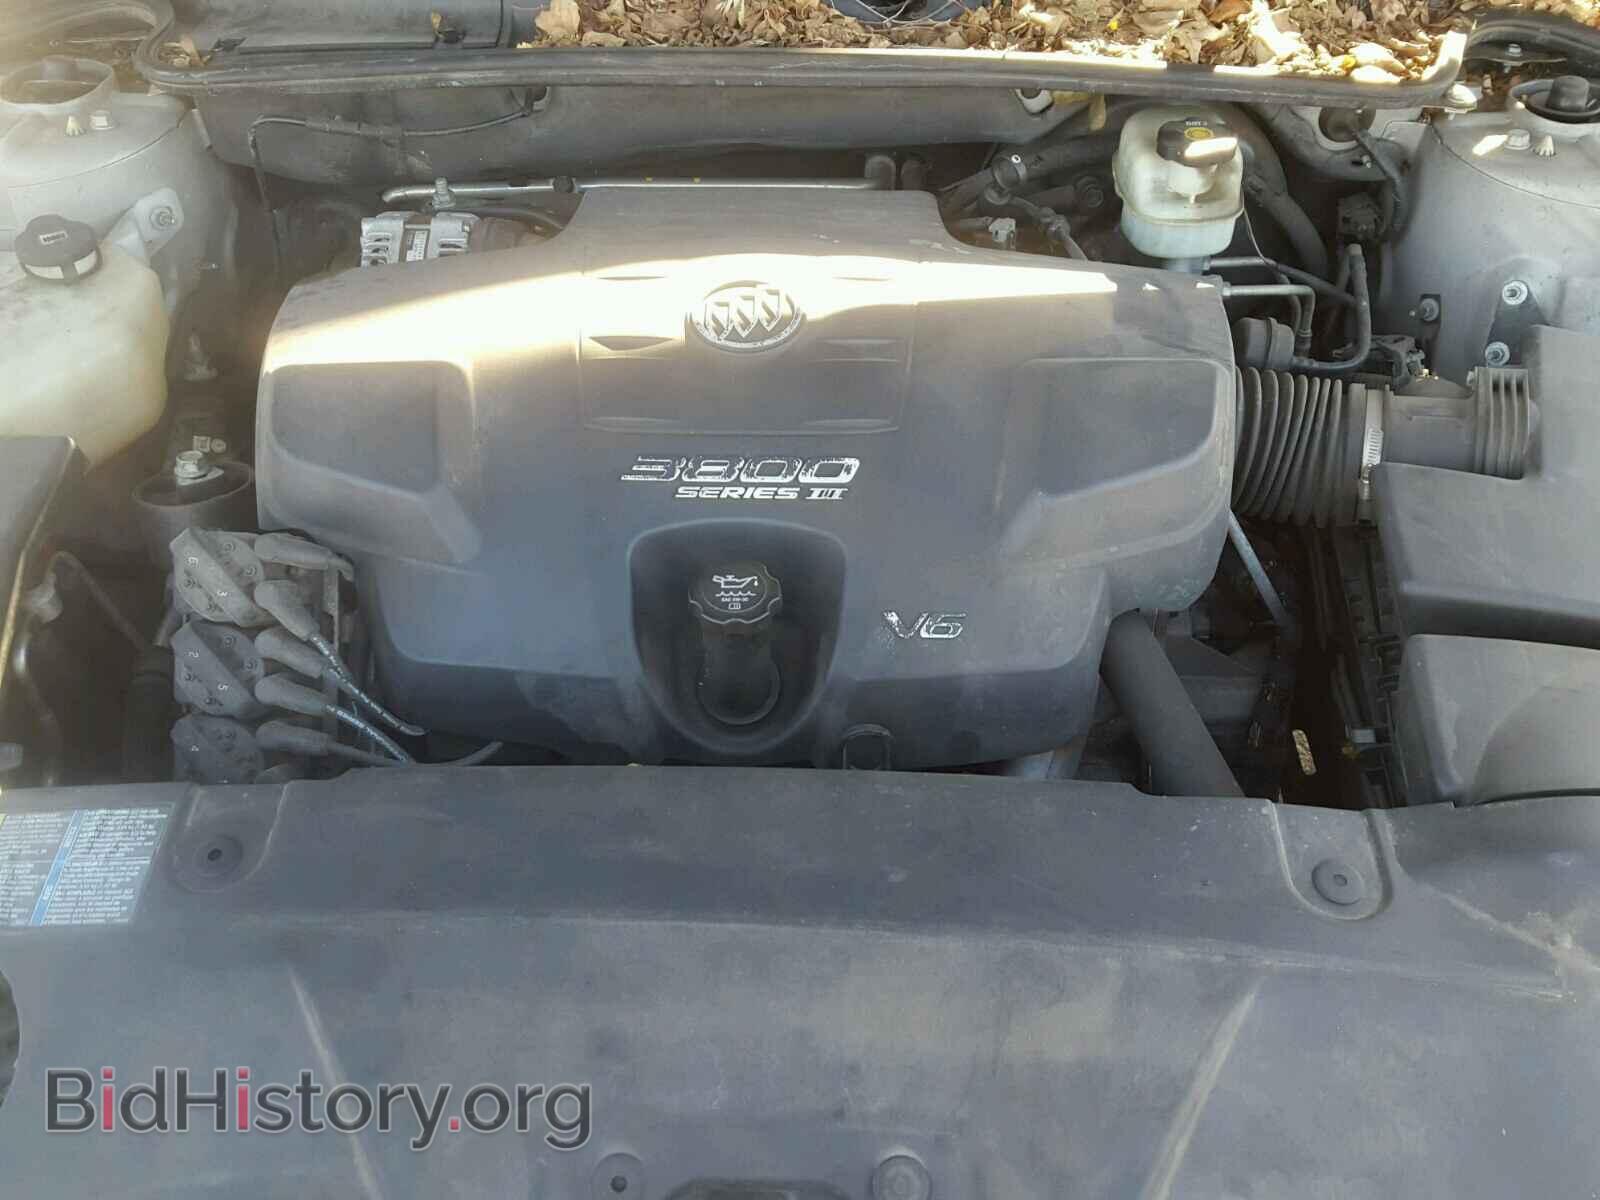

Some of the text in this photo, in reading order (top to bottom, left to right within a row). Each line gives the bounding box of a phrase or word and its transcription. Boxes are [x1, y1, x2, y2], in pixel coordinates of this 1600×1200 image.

[621, 456, 860, 484] 3800
[675, 486, 848, 500] SERIES III
[882, 610, 966, 639] V6
